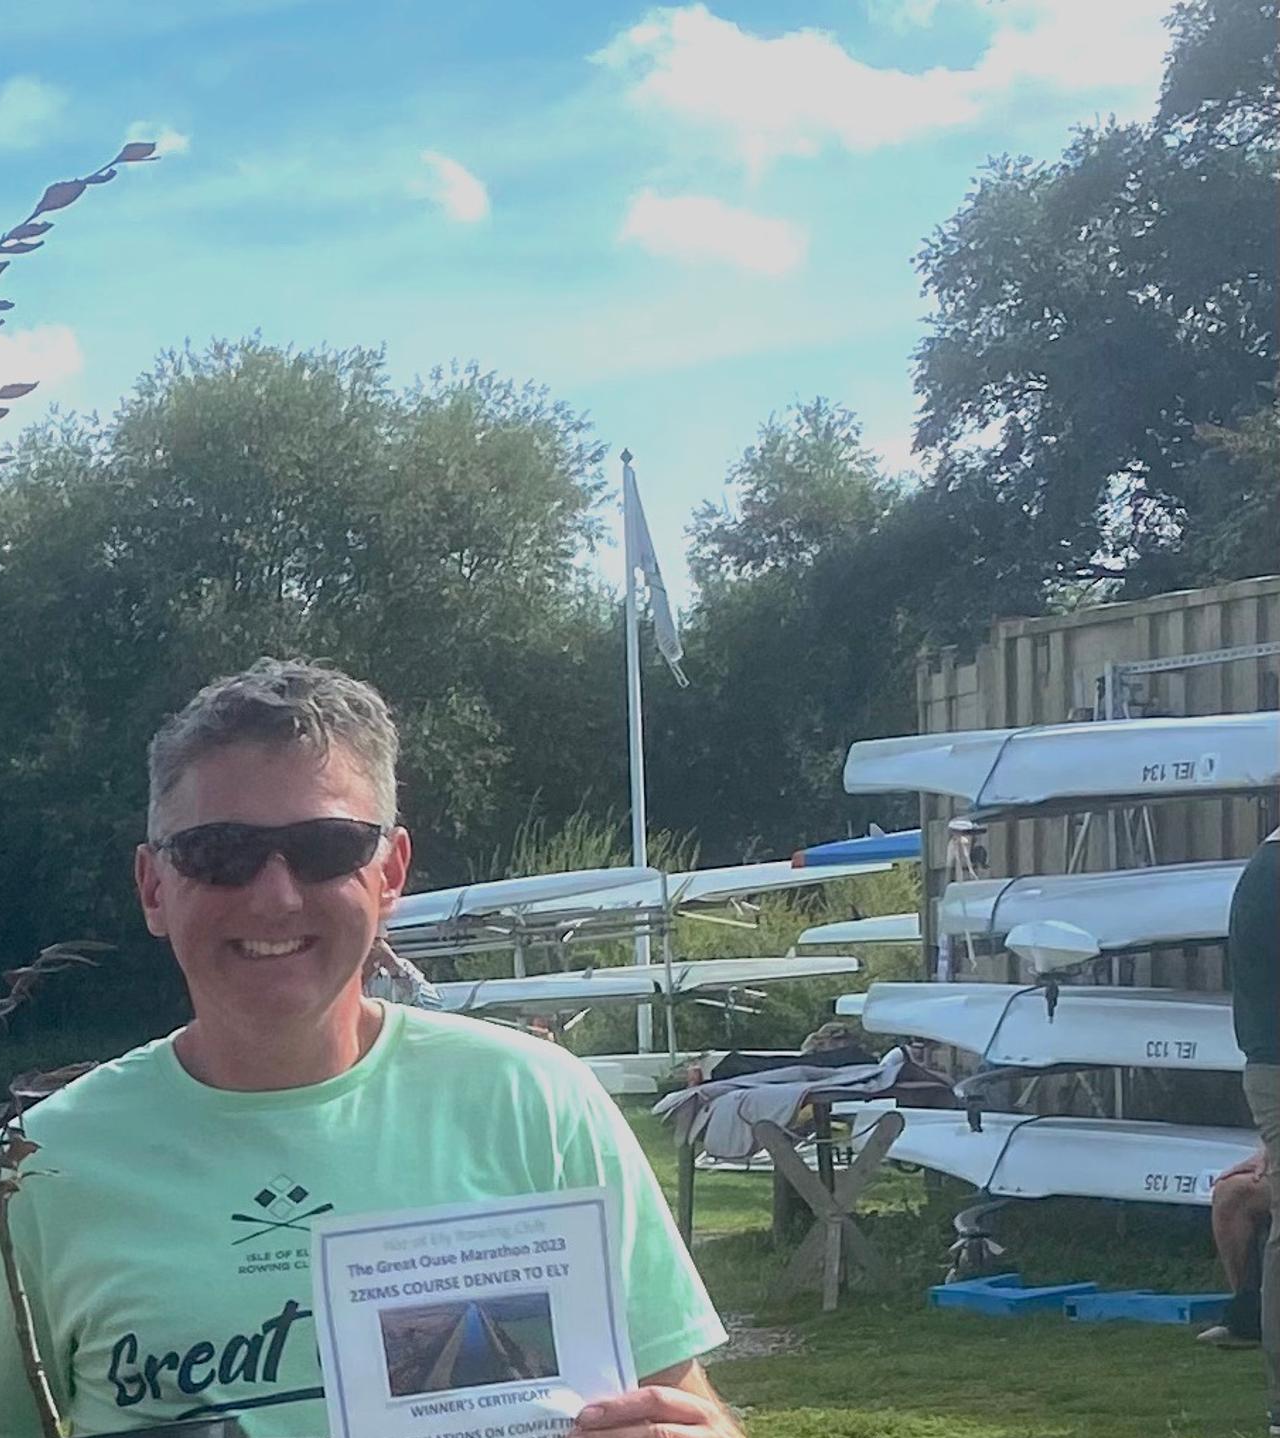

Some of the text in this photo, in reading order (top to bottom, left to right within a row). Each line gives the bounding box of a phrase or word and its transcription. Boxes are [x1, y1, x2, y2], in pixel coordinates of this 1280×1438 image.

[296, 1249, 309, 1258] EL
[346, 1237, 566, 1278] The Great Ouse Marathon 2023
[349, 1264, 569, 1303] 22KMS COURSE DENVER TO ELY
[108, 1299, 313, 1407] Great
[410, 1398, 475, 1418] WINNER'S
